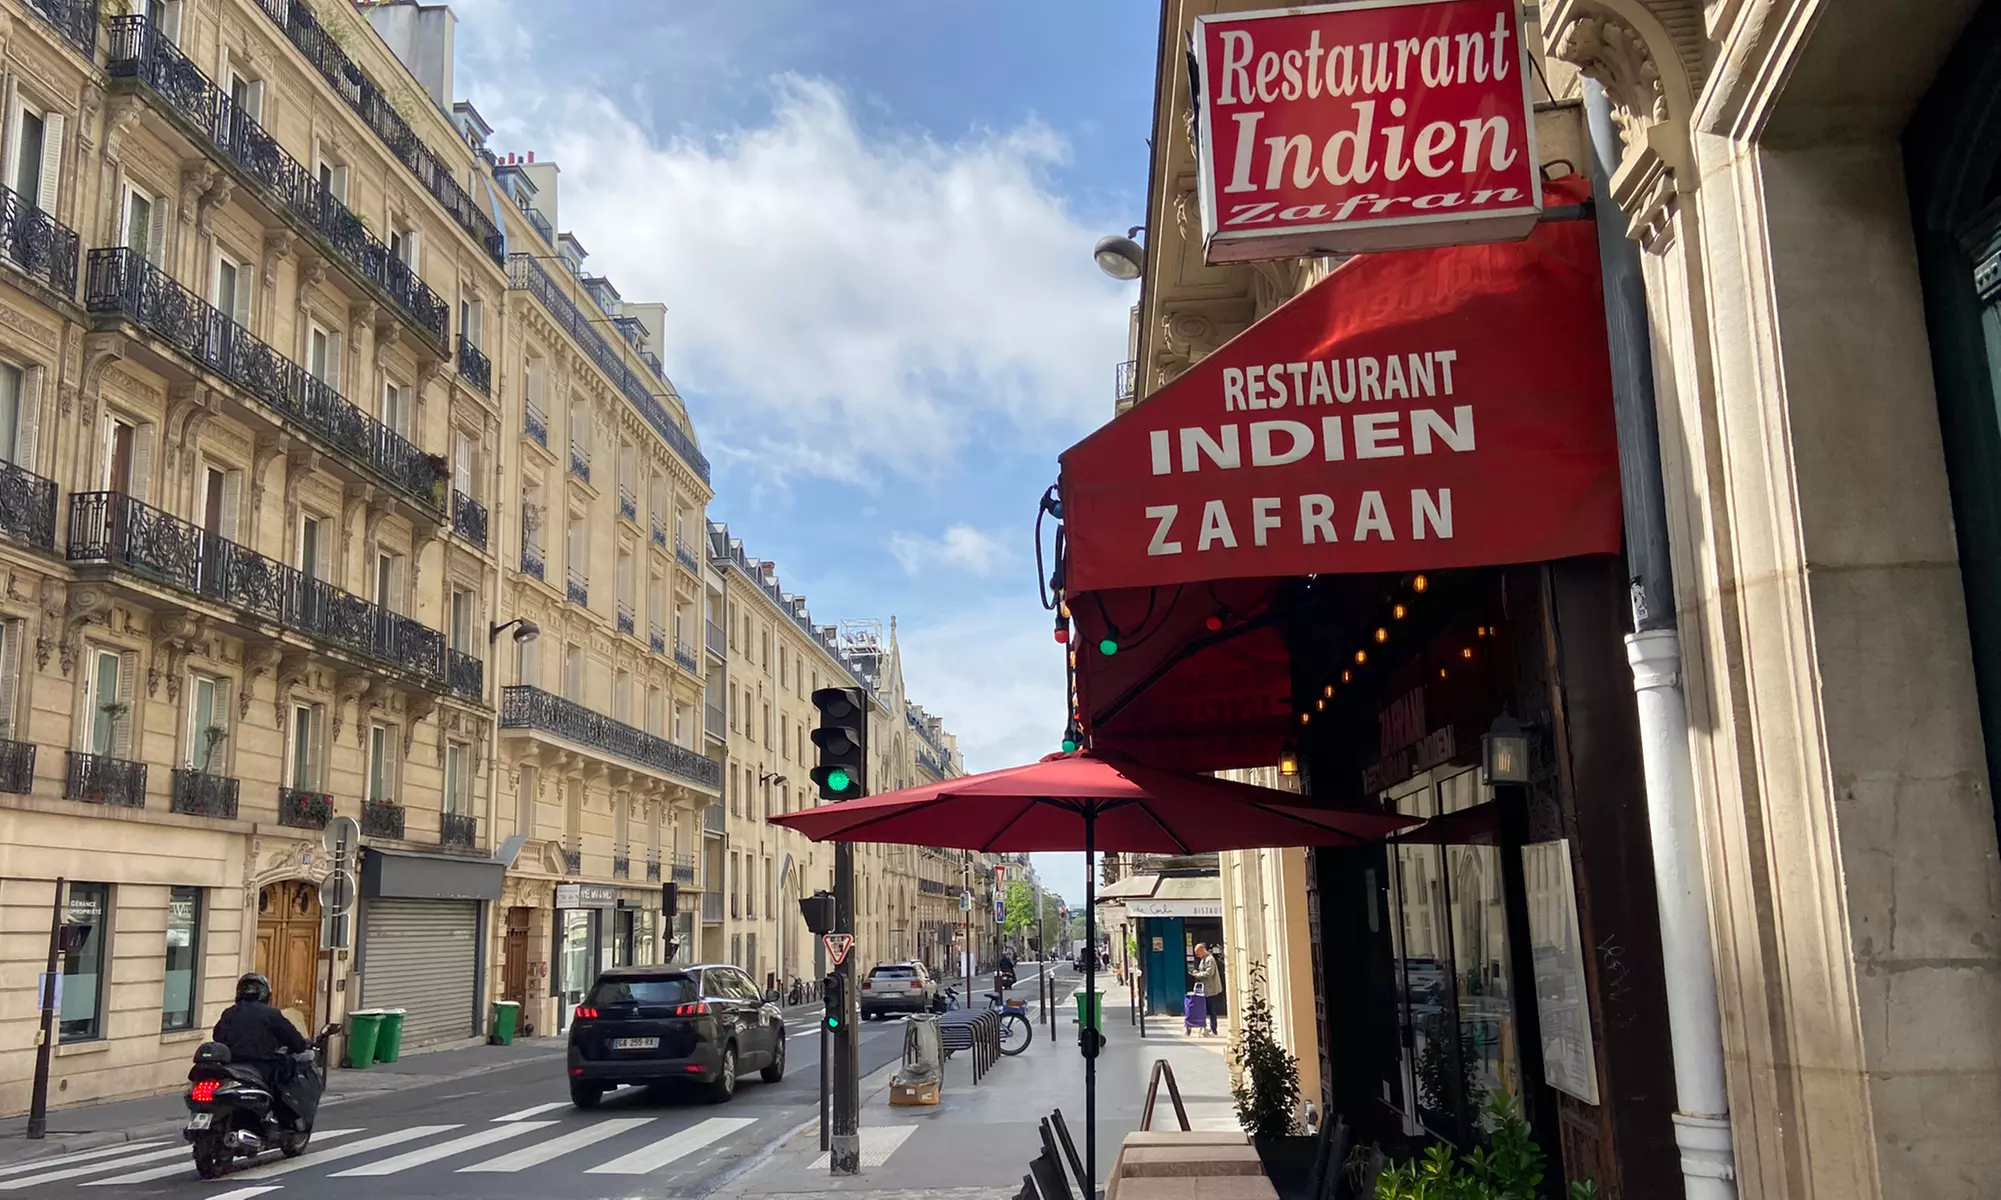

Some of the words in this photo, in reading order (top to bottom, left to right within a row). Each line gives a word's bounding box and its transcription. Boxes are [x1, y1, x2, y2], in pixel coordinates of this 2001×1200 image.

[1217, 12, 1509, 105] Restaurant
[1224, 99, 1517, 195] Indien
[1225, 187, 1524, 225] Zafran
[1223, 350, 1457, 412] RESTAURANT
[1149, 405, 1476, 475] INDIEN
[1146, 488, 1453, 555] ZAFRAN
